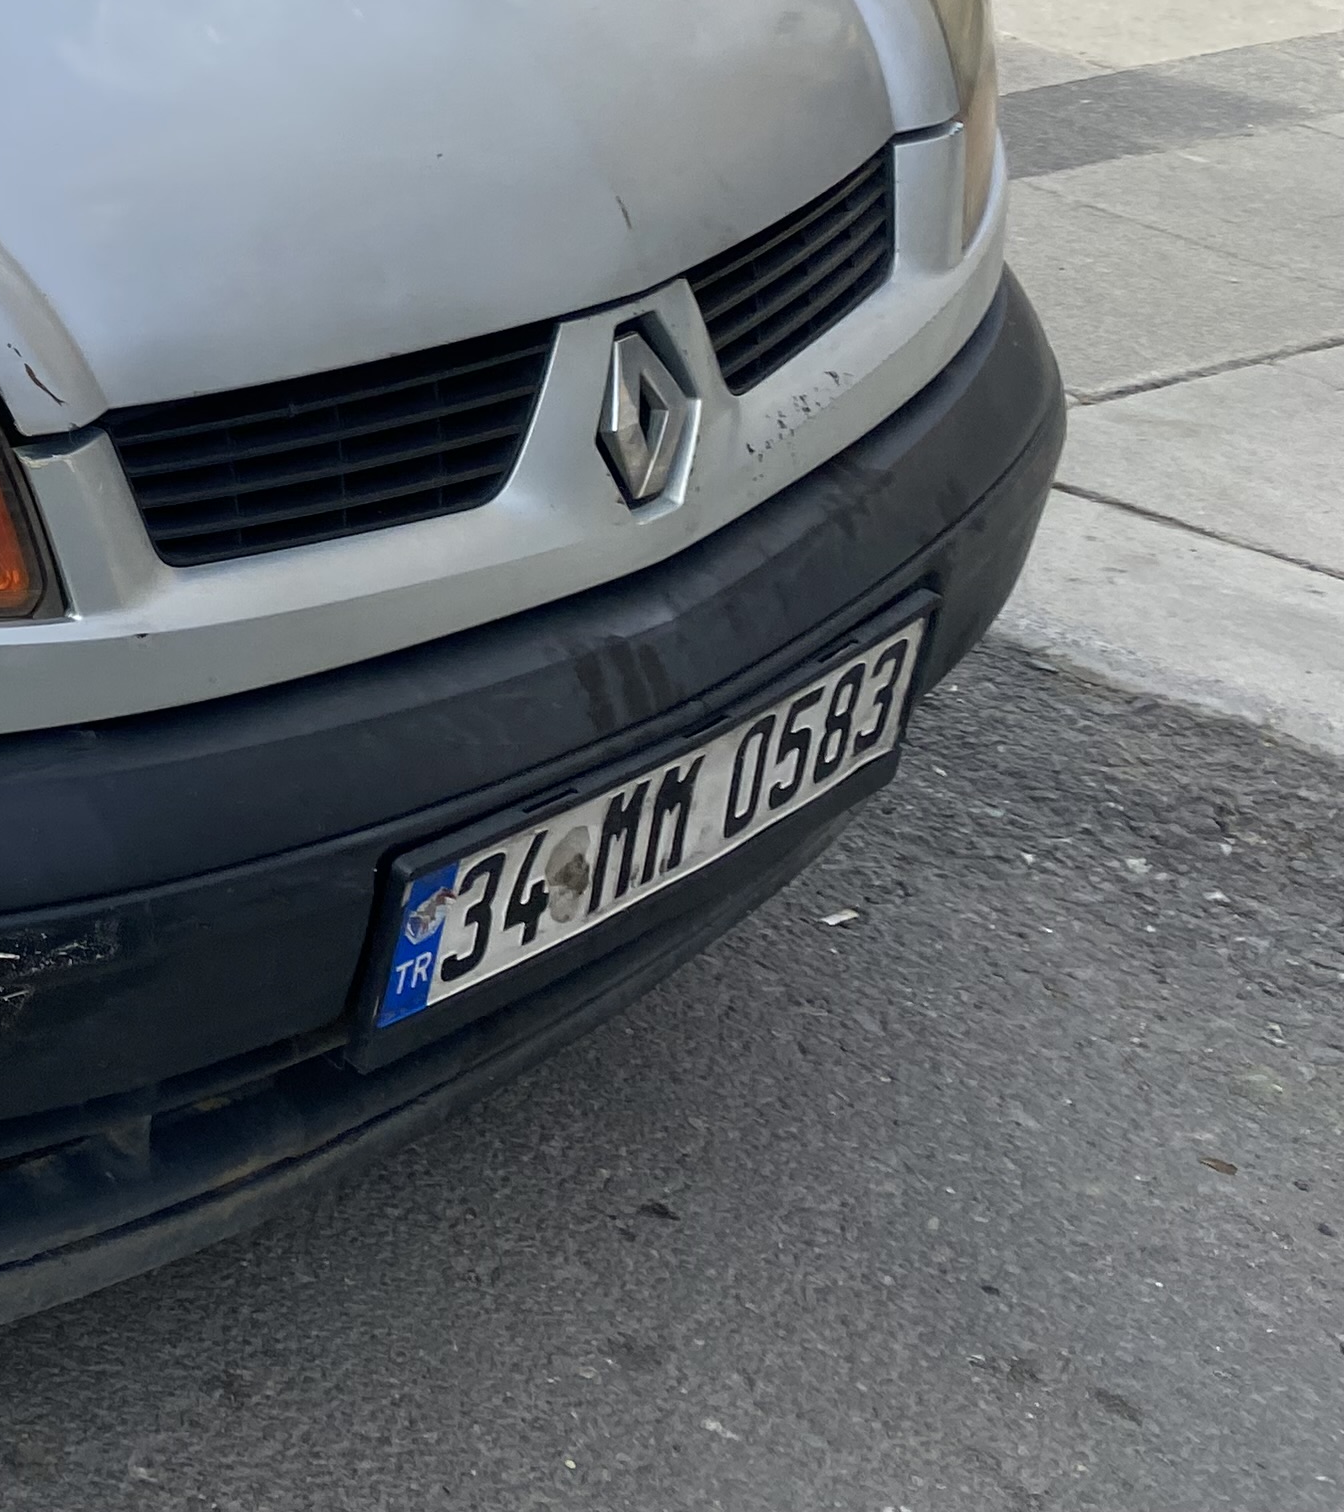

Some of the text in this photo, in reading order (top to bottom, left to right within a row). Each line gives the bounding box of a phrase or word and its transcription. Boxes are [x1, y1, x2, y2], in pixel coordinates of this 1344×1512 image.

[396, 638, 909, 995] TR 34 MM 0583
